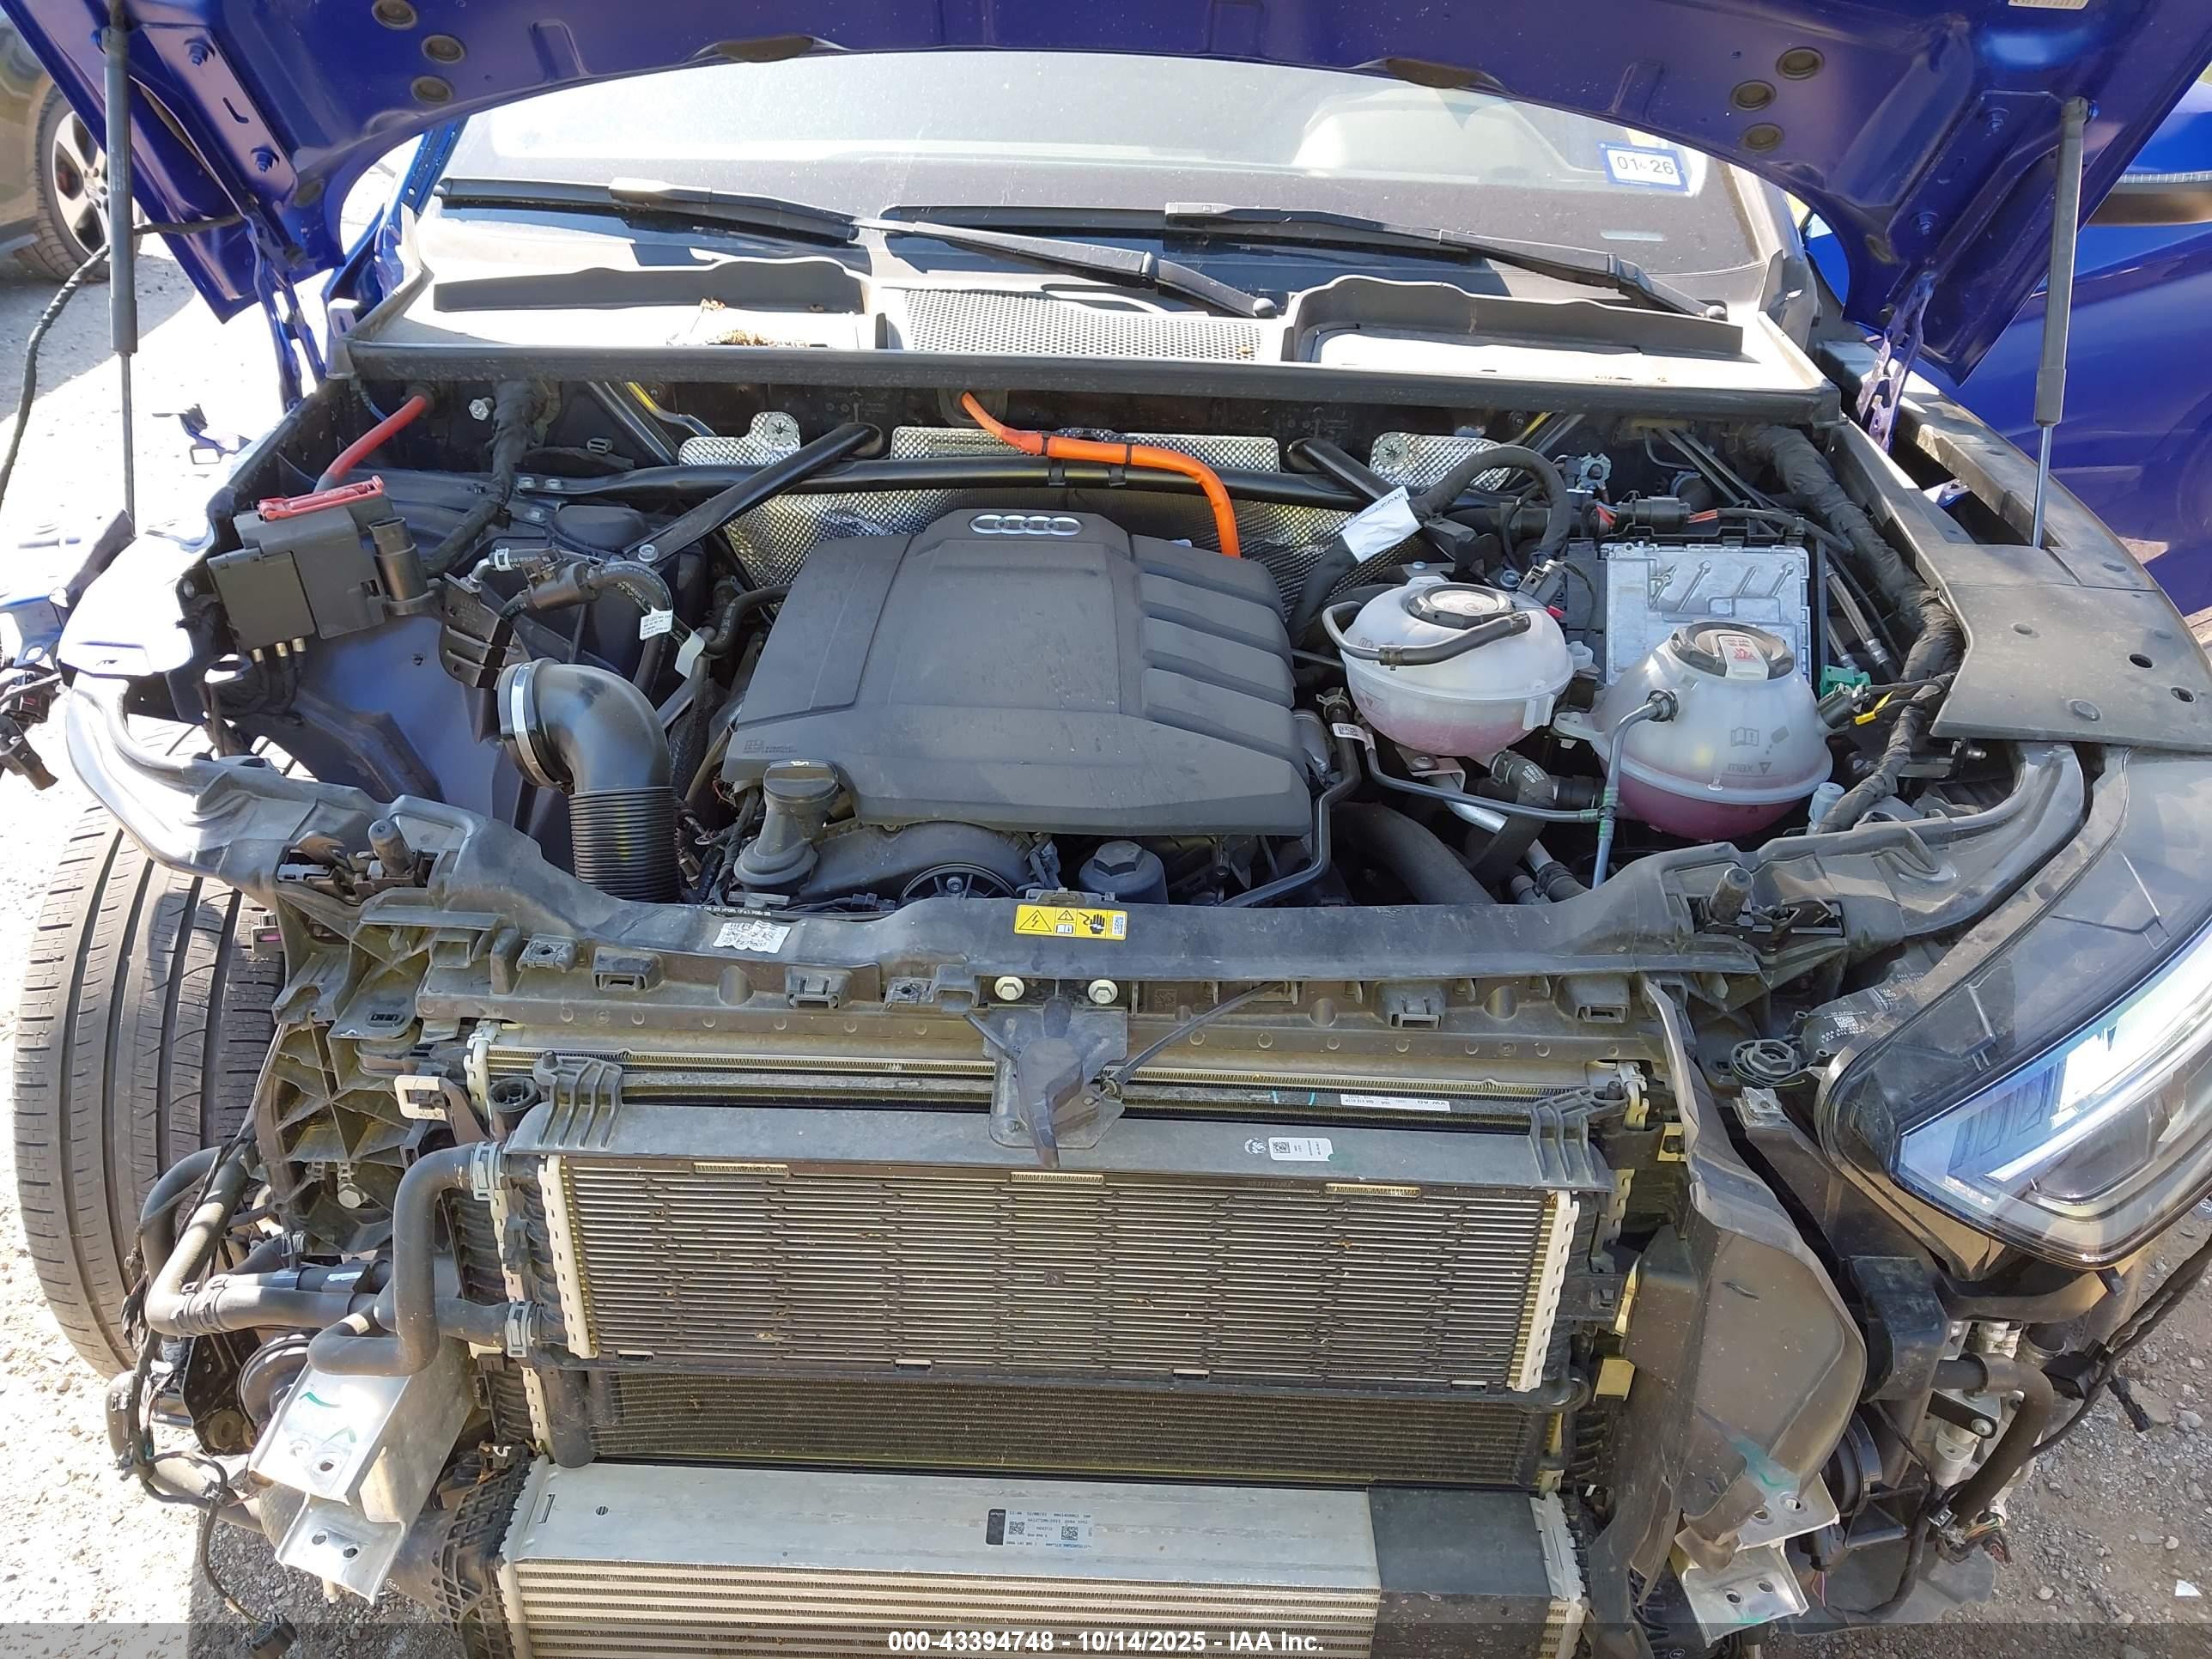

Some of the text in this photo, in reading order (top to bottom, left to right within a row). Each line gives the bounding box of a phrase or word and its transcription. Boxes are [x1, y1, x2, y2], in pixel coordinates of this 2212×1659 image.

[1616, 155, 1674, 175] 01 26
[1727, 763, 1753, 773] max
